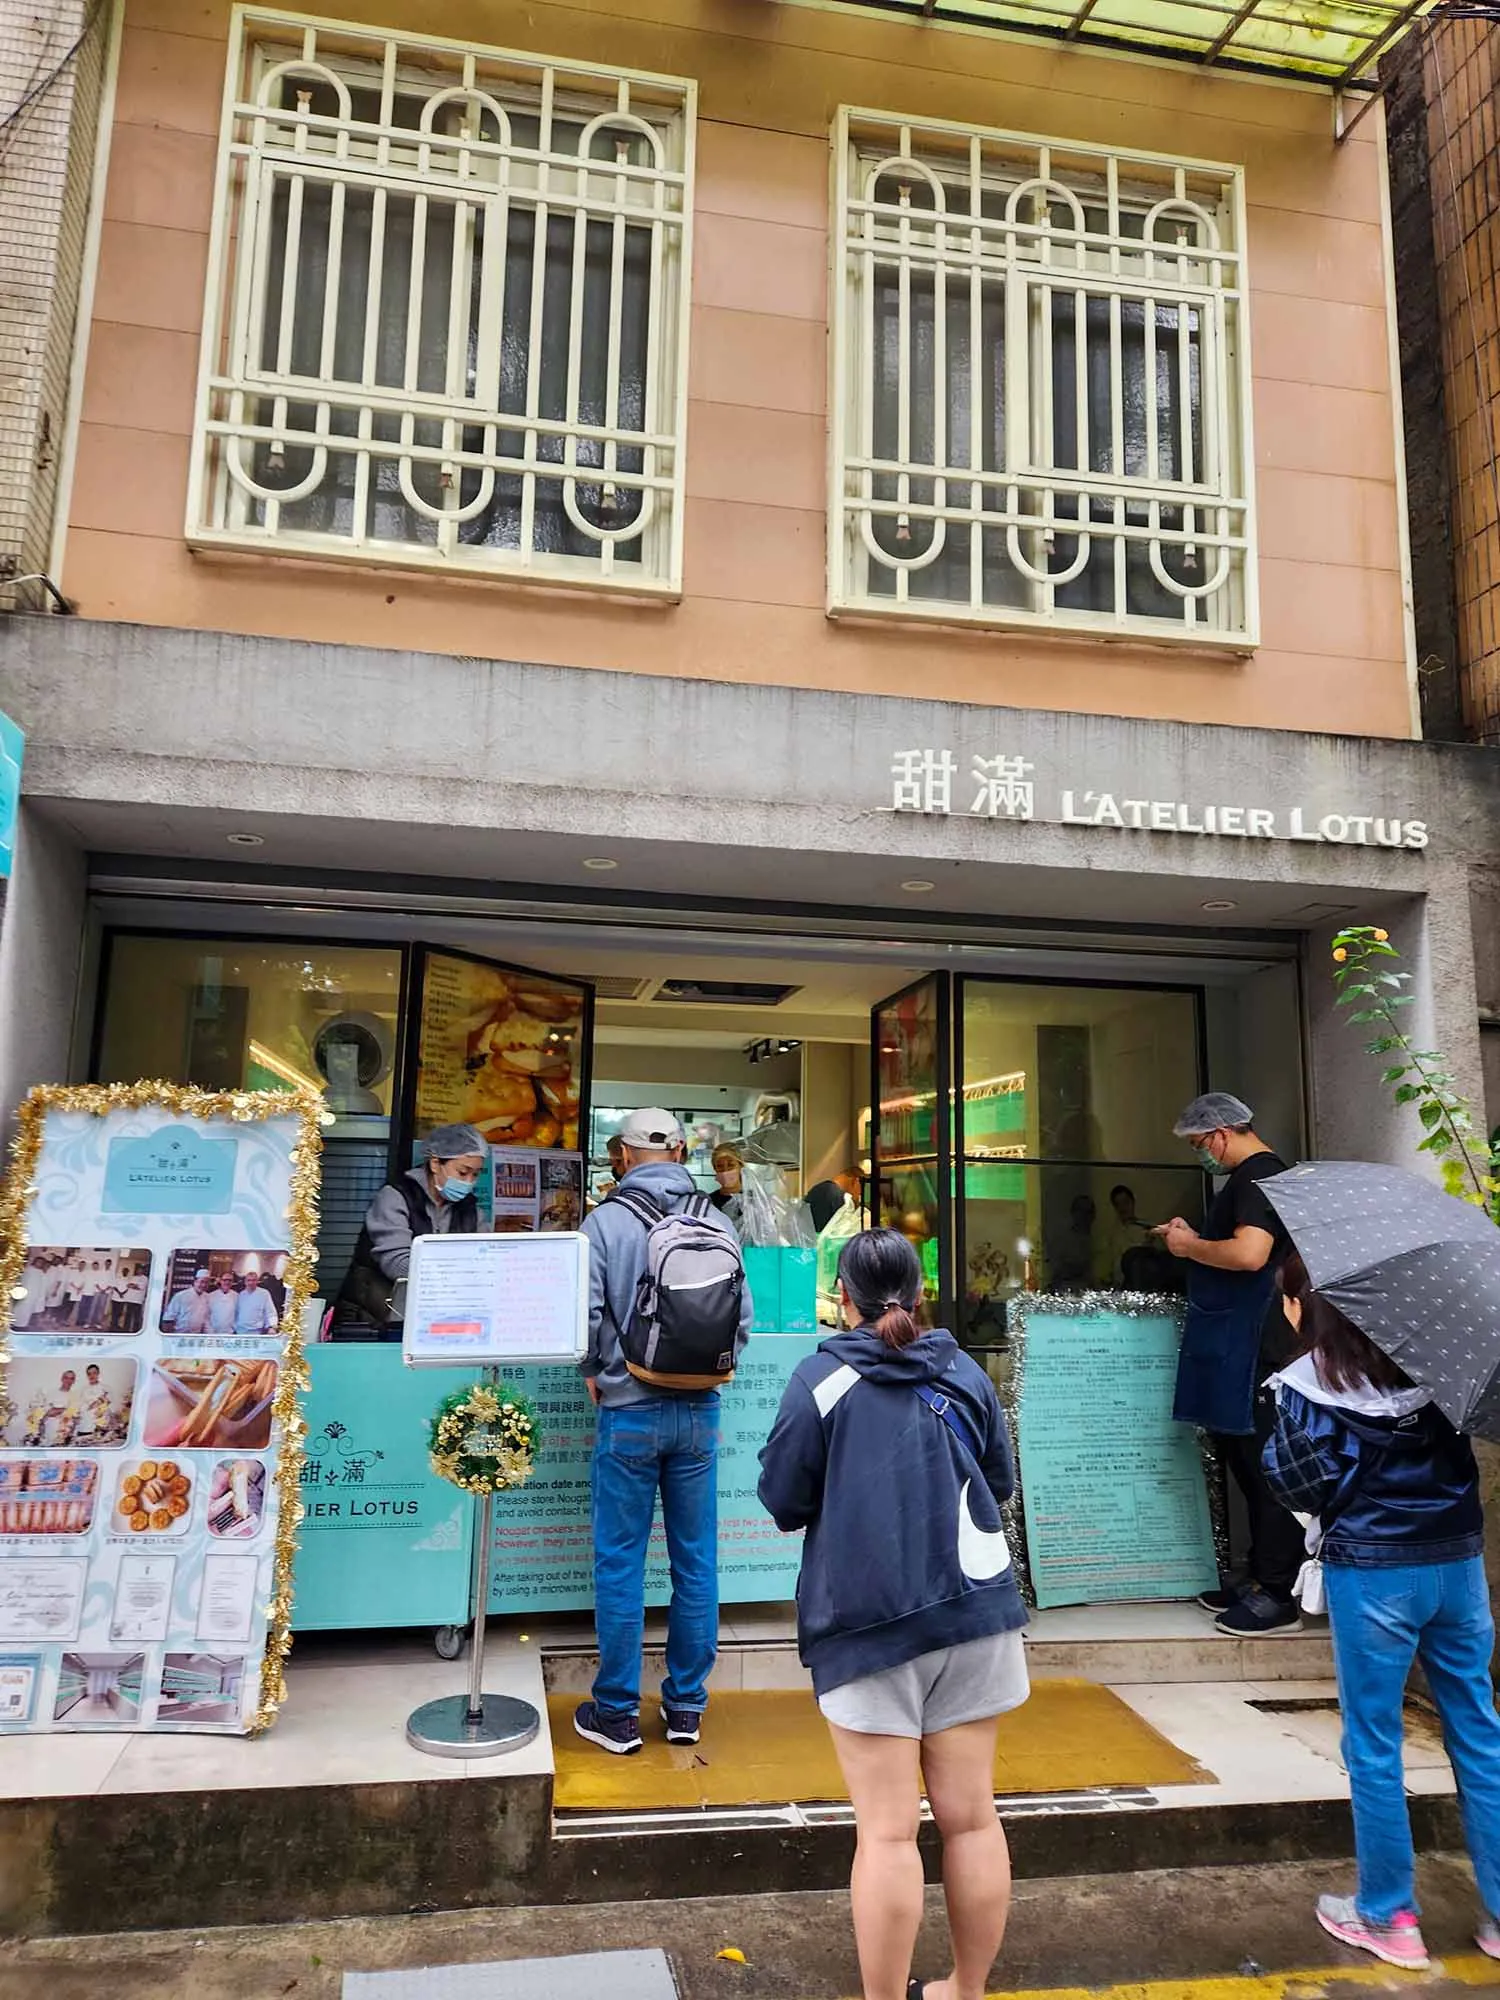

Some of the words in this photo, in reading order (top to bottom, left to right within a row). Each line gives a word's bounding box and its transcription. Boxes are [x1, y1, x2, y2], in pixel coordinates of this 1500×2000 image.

[551, 1480, 573, 1489] date
[496, 1495, 529, 1505] Please
[531, 1495, 555, 1504] store
[350, 1500, 418, 1516] LOTUS
[496, 1509, 514, 1518] and
[517, 1508, 543, 1517] avoid
[545, 1507, 580, 1517] contact
[748, 1562, 798, 1574] temperature
[494, 1573, 515, 1583] After
[516, 1572, 544, 1583] taking
[545, 1572, 561, 1581] out
[573, 1570, 587, 1579] the
[492, 1587, 503, 1598] by
[505, 1586, 530, 1597] using
